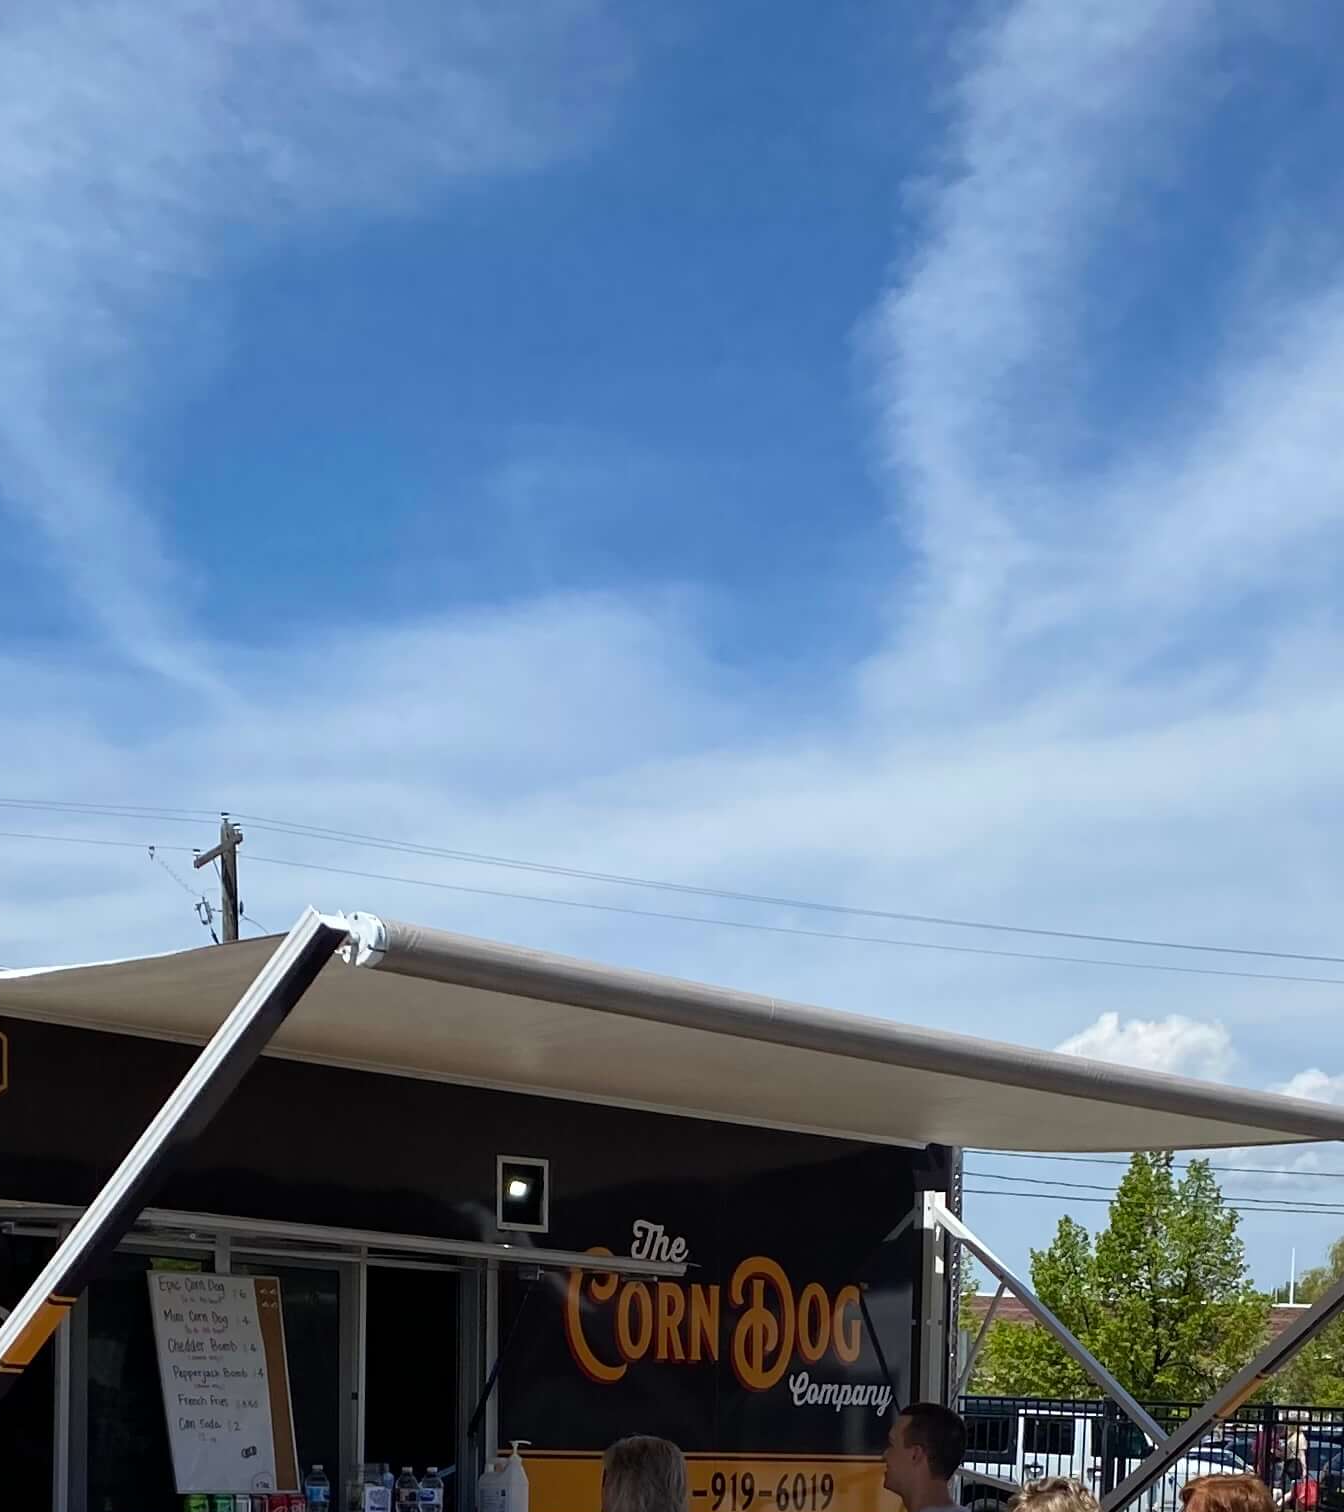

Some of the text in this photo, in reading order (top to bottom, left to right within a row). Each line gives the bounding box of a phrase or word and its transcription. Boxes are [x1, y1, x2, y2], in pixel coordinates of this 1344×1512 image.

[631, 1218, 688, 1262] The
[184, 1278, 205, 1292] Corn
[208, 1280, 225, 1297] Dog
[189, 1310, 208, 1322] Corn
[212, 1311, 228, 1329] Dog
[566, 1246, 861, 1391] CORN DOG
[788, 1372, 894, 1416] Company
[692, 1471, 835, 1512] -919-6019
